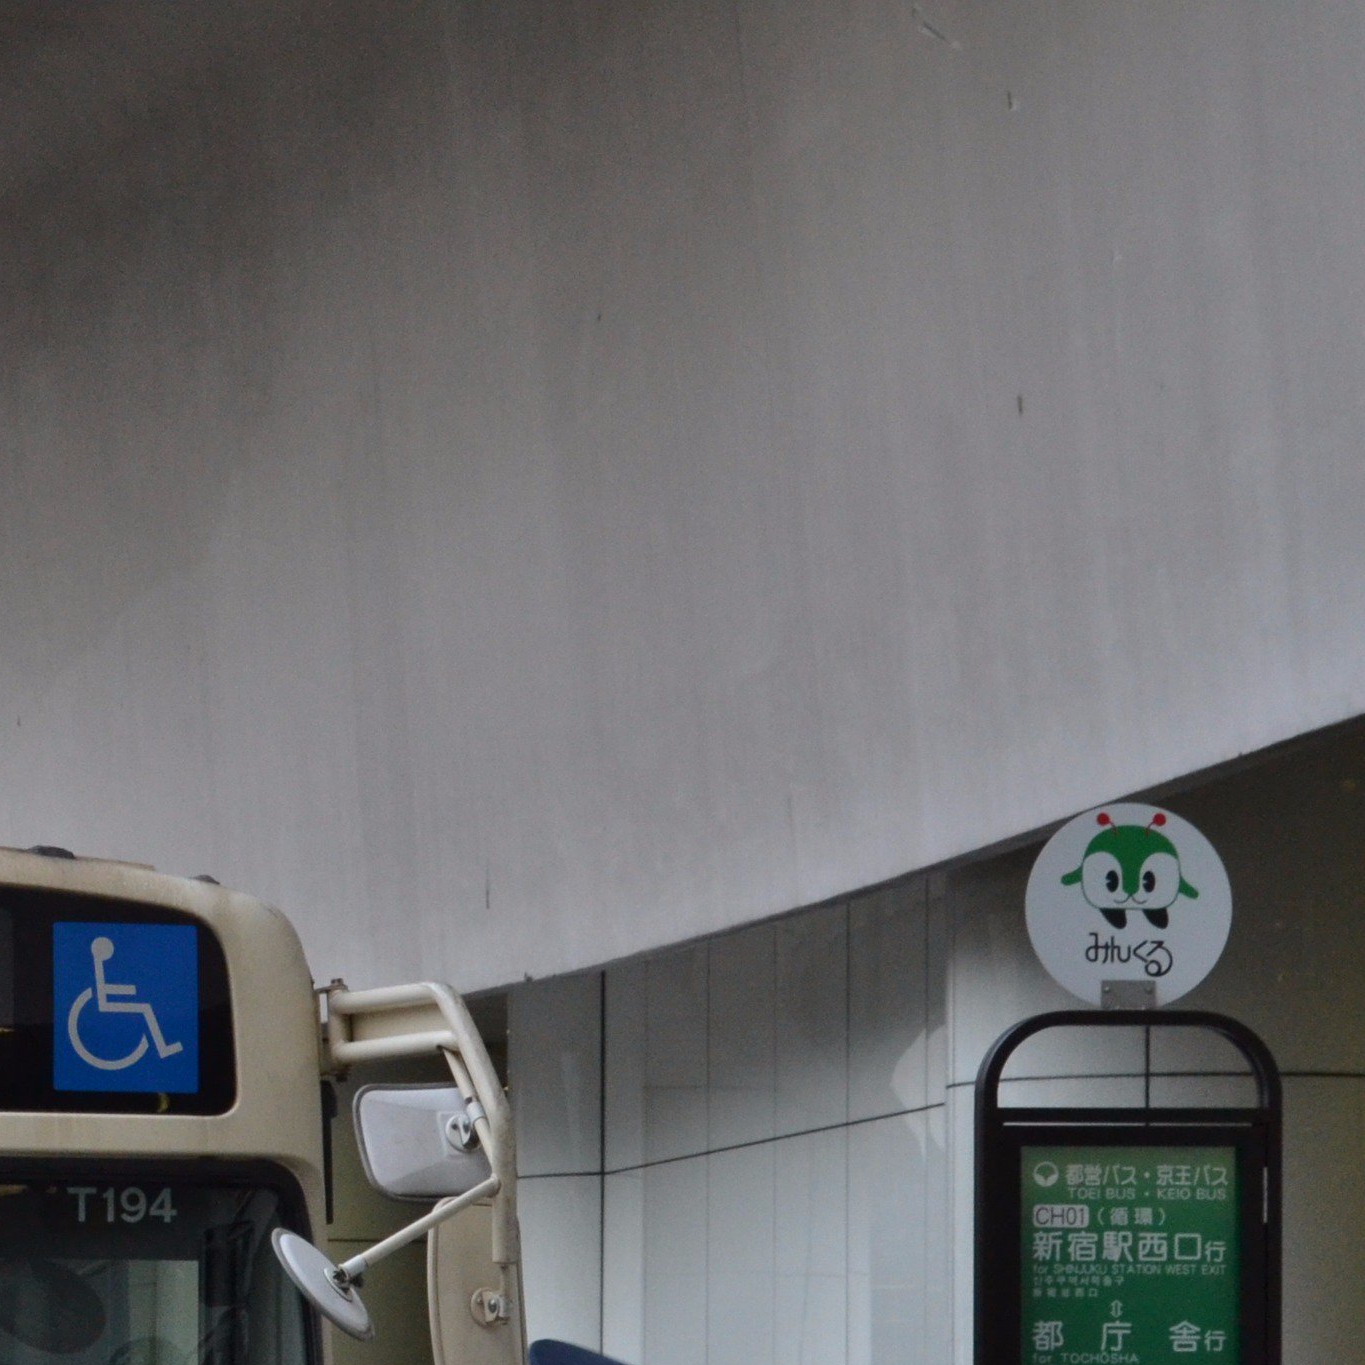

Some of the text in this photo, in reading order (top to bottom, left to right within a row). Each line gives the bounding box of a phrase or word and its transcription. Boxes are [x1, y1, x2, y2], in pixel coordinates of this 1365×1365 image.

[1069, 1187, 1101, 1199] TOEI
[1105, 1187, 1136, 1199] BUS
[1157, 1188, 1191, 1199] KEIO
[1196, 1188, 1227, 1199] BUS
[69, 1187, 177, 1223] T194
[1035, 1206, 1086, 1226] CH01
[1033, 1231, 1227, 1263] 新宿駅西口行
[1112, 1265, 1161, 1275] STATION
[1165, 1265, 1196, 1275] WEST
[1201, 1265, 1226, 1275] EXIT
